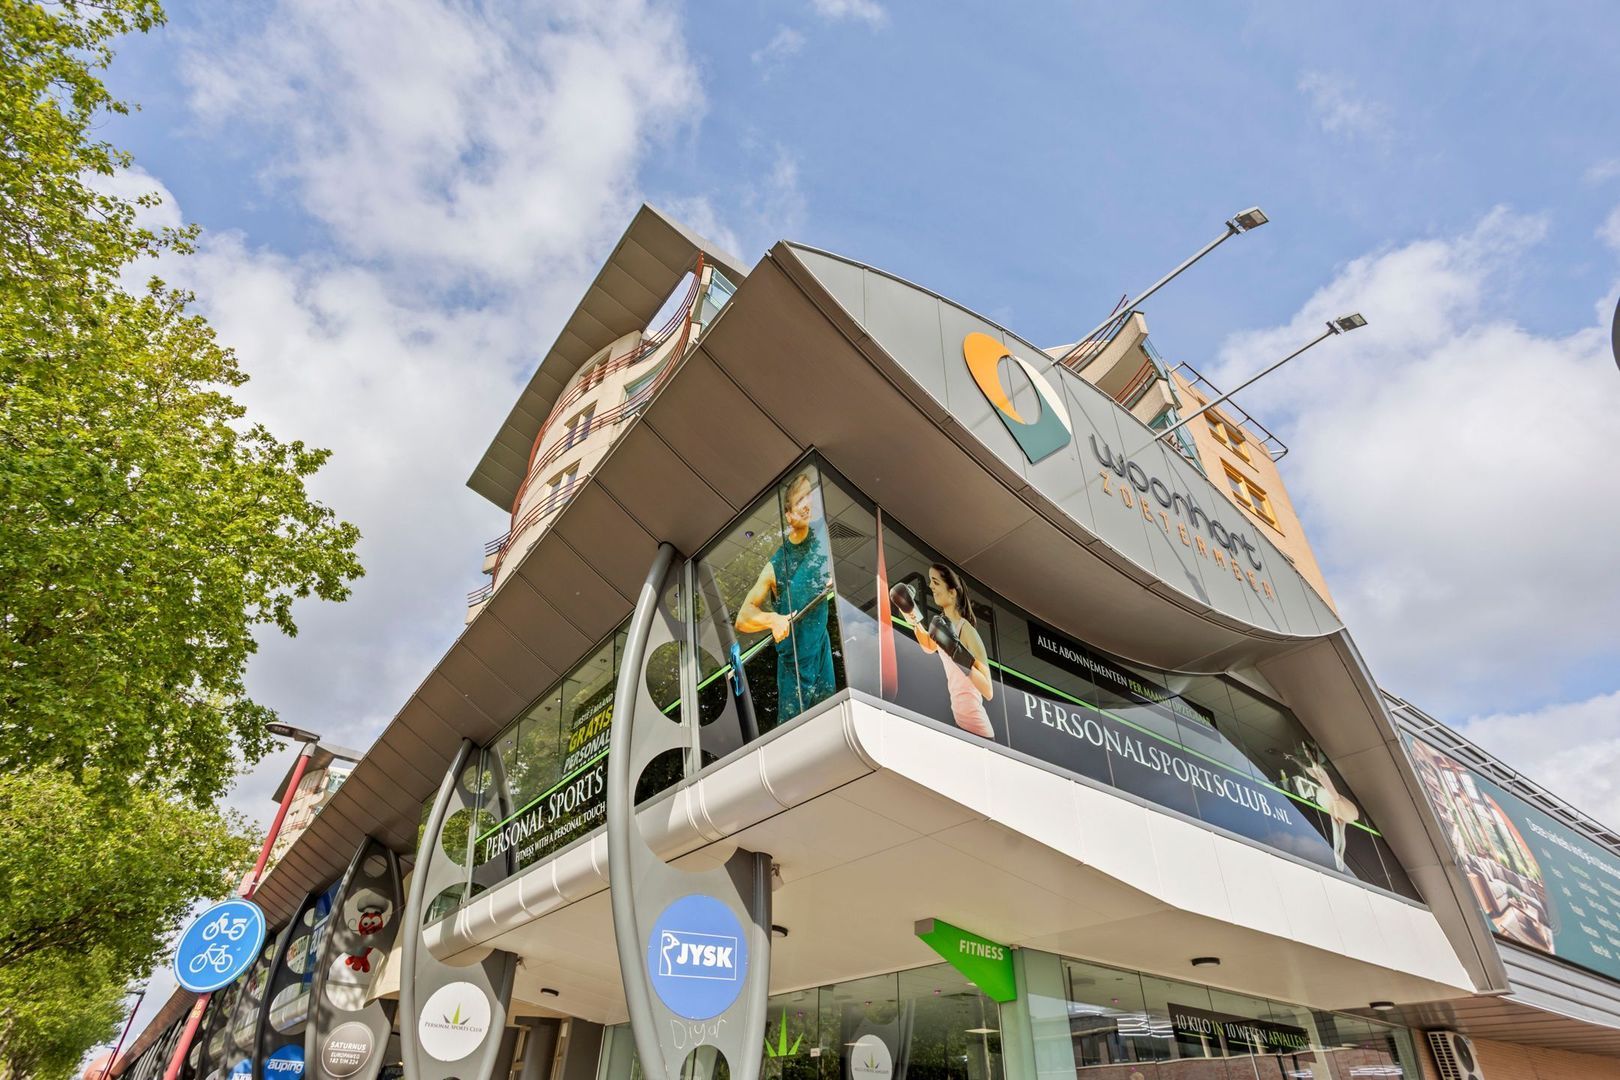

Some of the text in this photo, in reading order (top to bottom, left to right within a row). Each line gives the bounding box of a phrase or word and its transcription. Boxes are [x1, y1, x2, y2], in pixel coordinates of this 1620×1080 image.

[1089, 433, 1262, 571] woonhart
[1100, 471, 1274, 601] ZOETERMEER
[1037, 635, 1058, 653] ALLE
[1059, 646, 1128, 687] ABONNEMENTEN
[1128, 679, 1144, 695] PER
[563, 729, 611, 773] PERSONAL
[569, 705, 613, 752] GRATIS
[1022, 691, 1293, 825] PERSONALSPORTSCLUB.NL
[484, 766, 603, 863] PERSONAL SPORTS
[535, 835, 549, 851] WITH
[554, 816, 582, 840] PERSONAL
[583, 801, 606, 822] TOUCH
[676, 943, 733, 969] JYSK
[959, 939, 1004, 961] FITNESS
[330, 1041, 367, 1051] SATURNUS
[424, 1021, 450, 1030] PERSONAL
[451, 1024, 469, 1032] SPORTS
[1175, 1014, 1187, 1029] 10
[1187, 1016, 1212, 1034] KILO
[1212, 1021, 1224, 1037] IN
[1225, 1023, 1236, 1039] 10
[1235, 1024, 1268, 1044] WEKEN
[268, 1061, 304, 1074] auping
